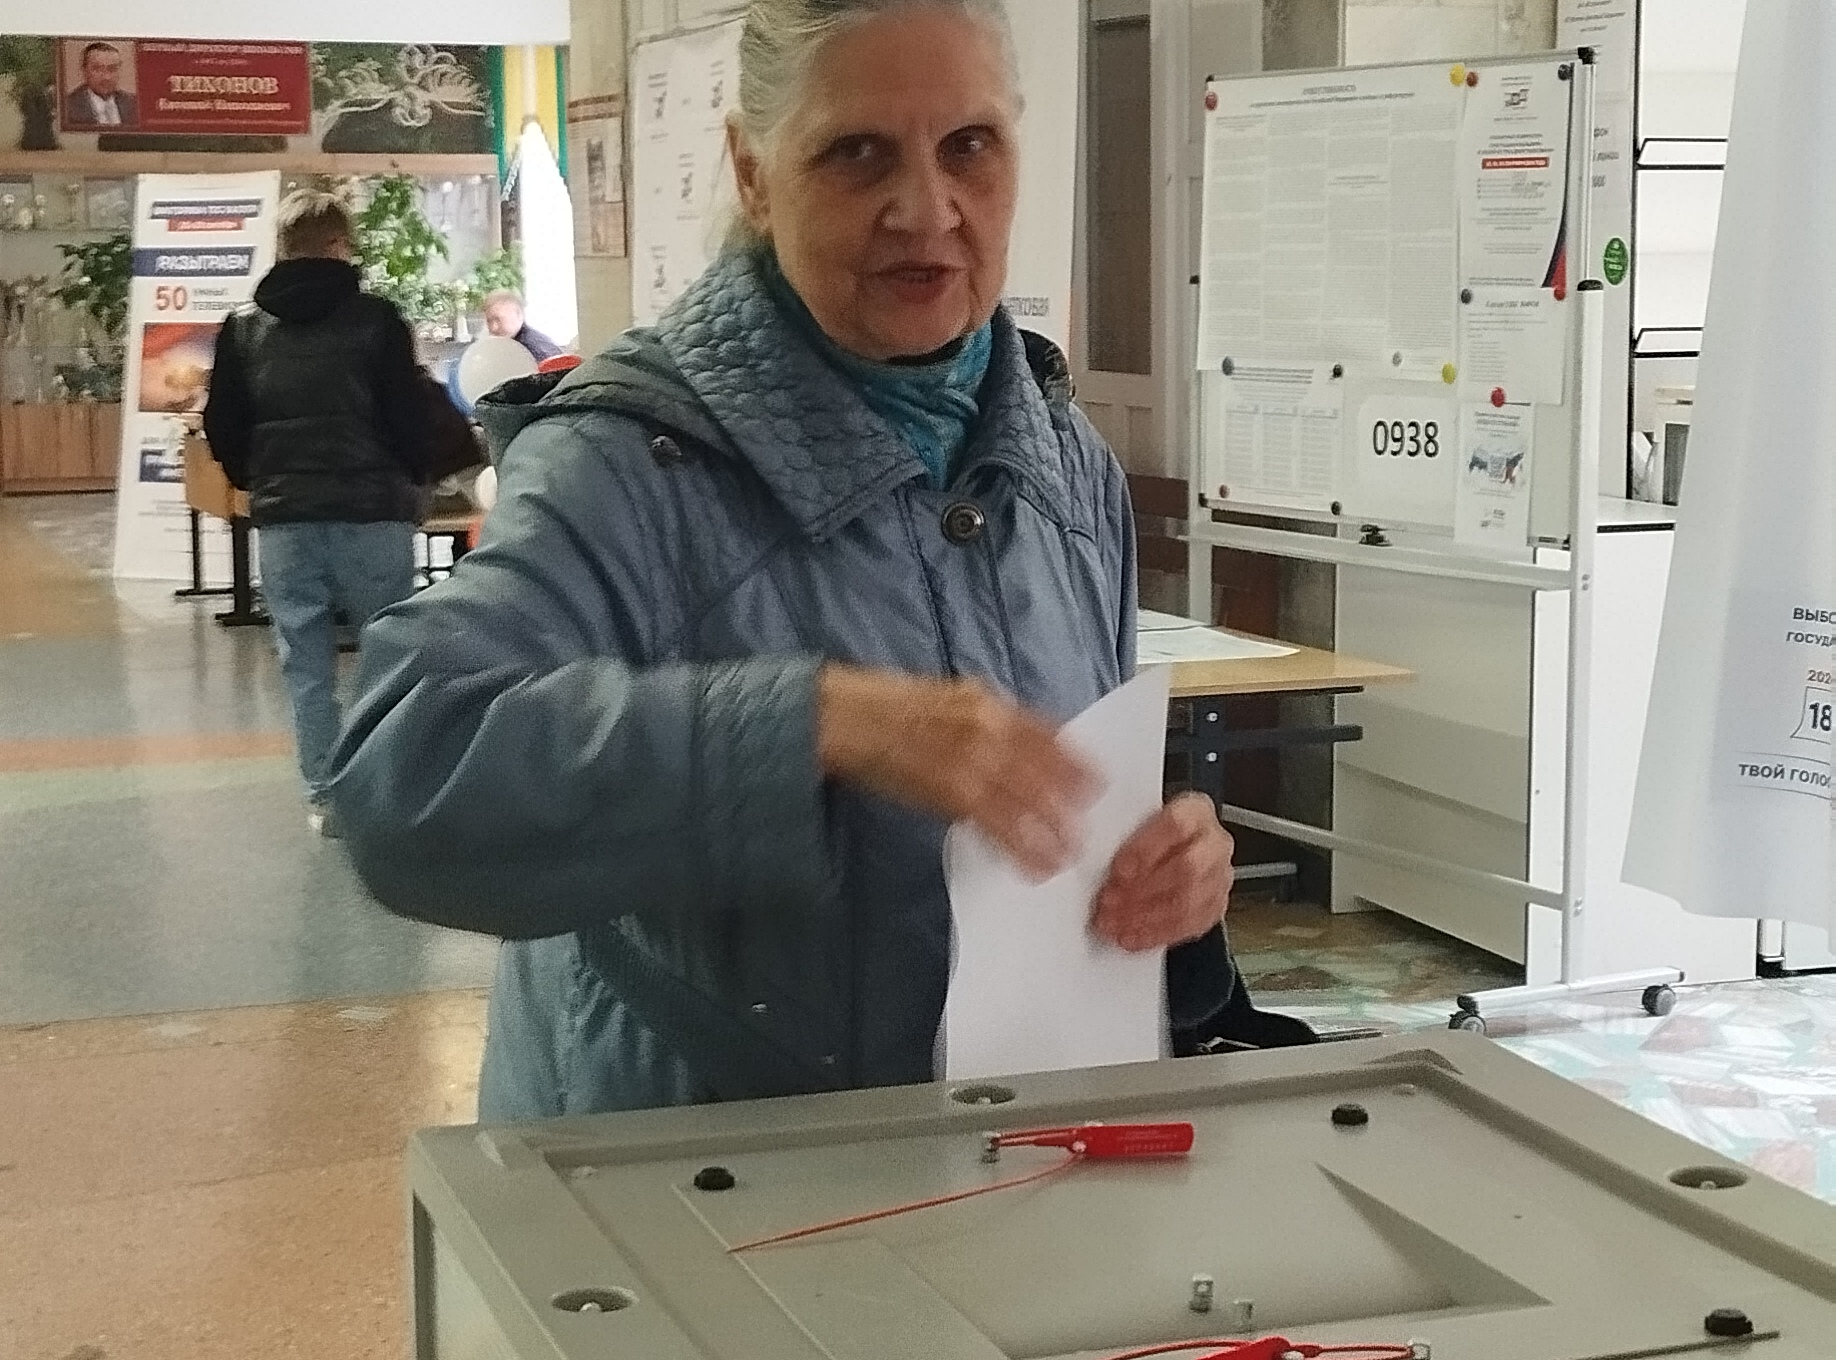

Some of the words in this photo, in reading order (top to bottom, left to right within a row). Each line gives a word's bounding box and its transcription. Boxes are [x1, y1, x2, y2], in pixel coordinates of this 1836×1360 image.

[155, 285, 188, 311] 50
[1372, 419, 1440, 458] 0938
[1786, 631, 1836, 648] ГОСУД
[1738, 763, 1786, 780] ТВОЙ
